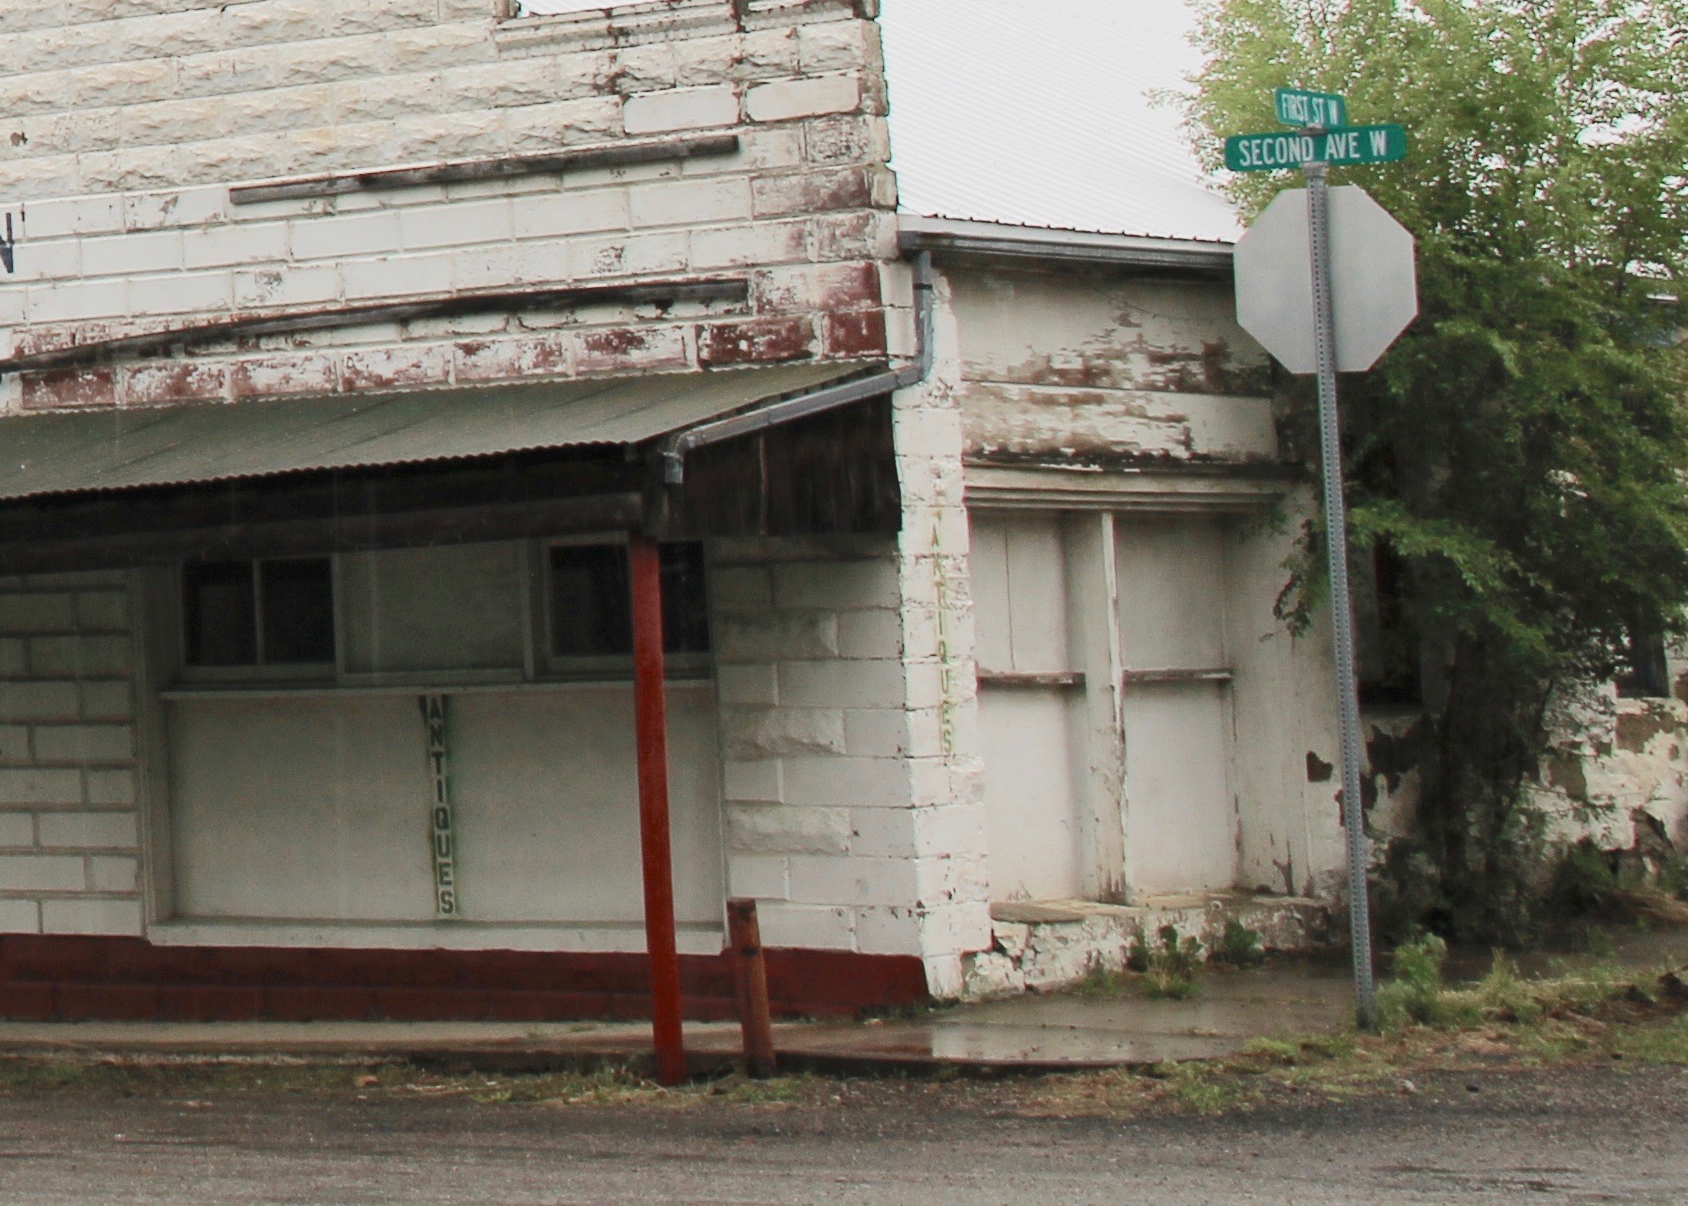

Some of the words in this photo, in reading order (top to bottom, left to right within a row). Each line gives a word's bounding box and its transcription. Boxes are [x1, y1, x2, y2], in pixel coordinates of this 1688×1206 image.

[1281, 93, 1309, 122] FIRST
[1311, 97, 1325, 125] ST
[1238, 136, 1315, 167] SECOND
[1324, 132, 1361, 160] AVE
[1369, 130, 1387, 157] W
[426, 696, 454, 915] ANTIQUES
